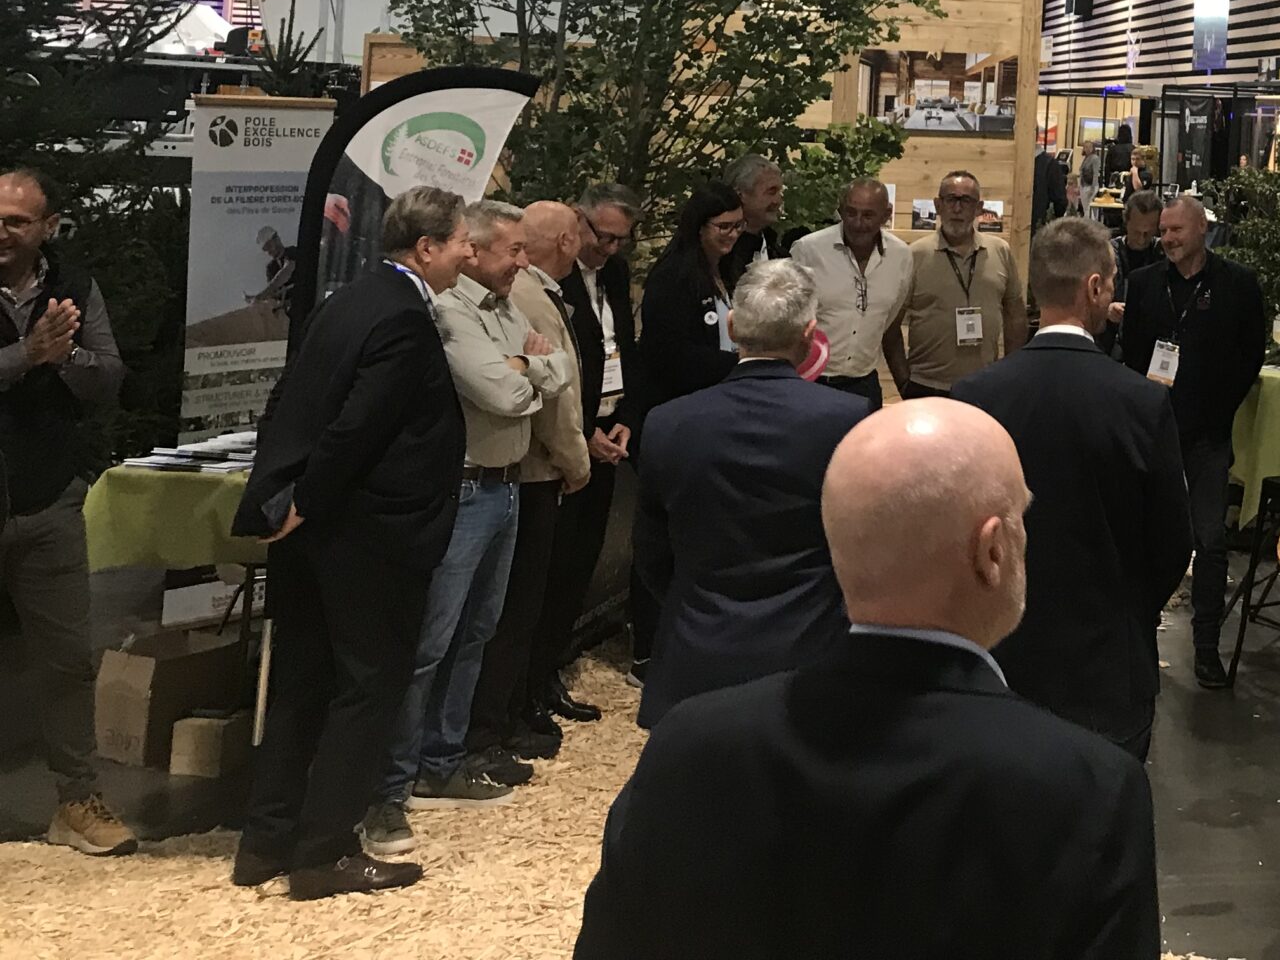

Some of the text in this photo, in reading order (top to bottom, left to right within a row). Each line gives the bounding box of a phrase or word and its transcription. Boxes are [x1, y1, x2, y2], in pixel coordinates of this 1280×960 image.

[245, 117, 276, 127] POLE
[244, 127, 321, 138] EXCELLENCE
[244, 138, 273, 147] BOIS
